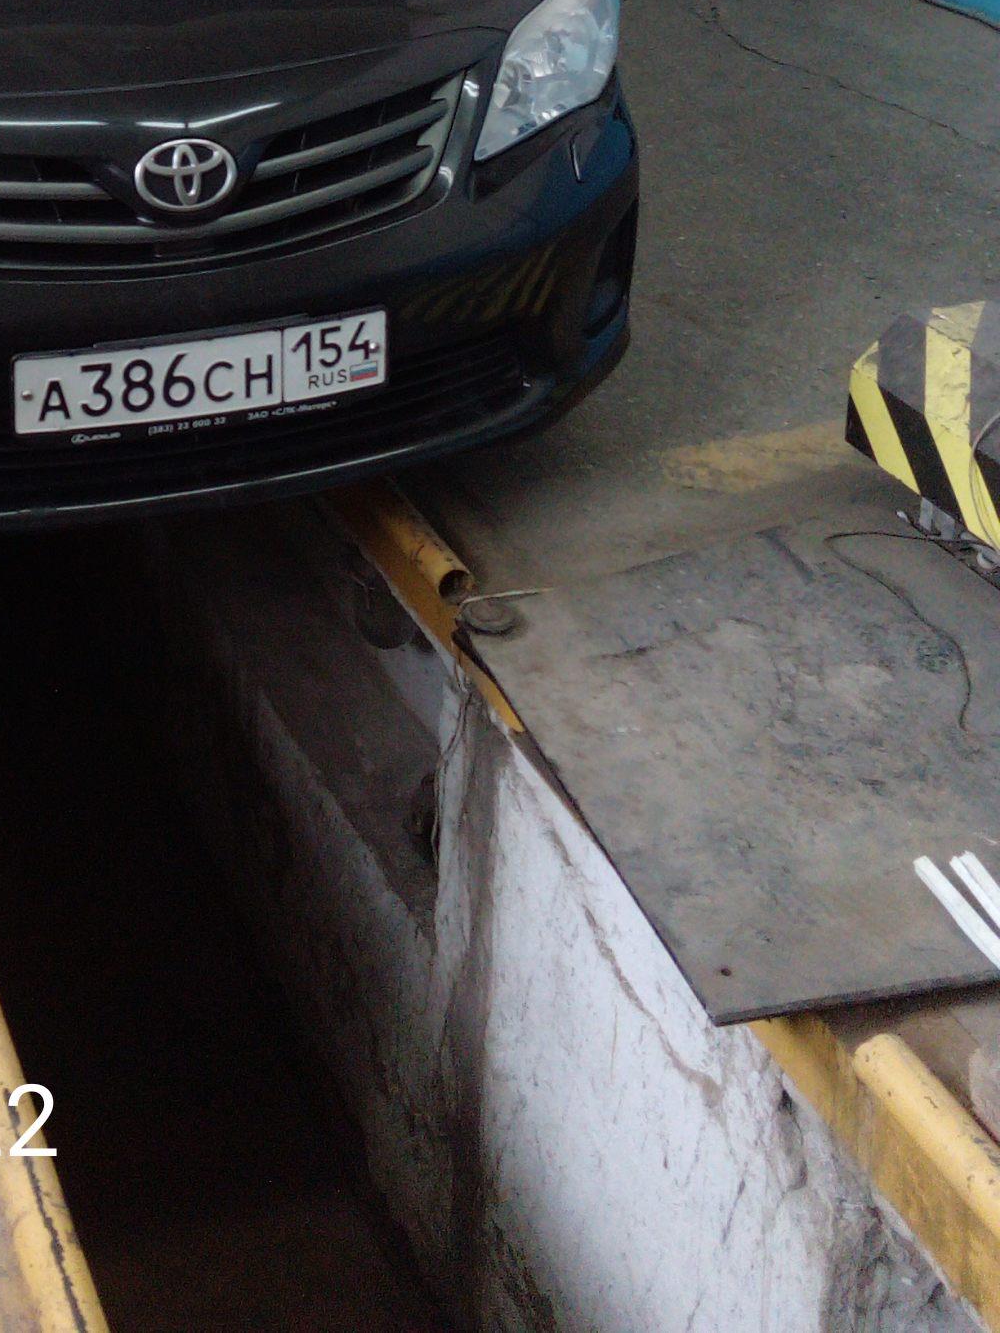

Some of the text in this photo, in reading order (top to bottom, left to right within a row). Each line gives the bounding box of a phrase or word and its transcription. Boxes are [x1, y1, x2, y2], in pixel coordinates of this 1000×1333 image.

[38, 321, 370, 422] А386СН 154
[308, 369, 347, 390] RUS
